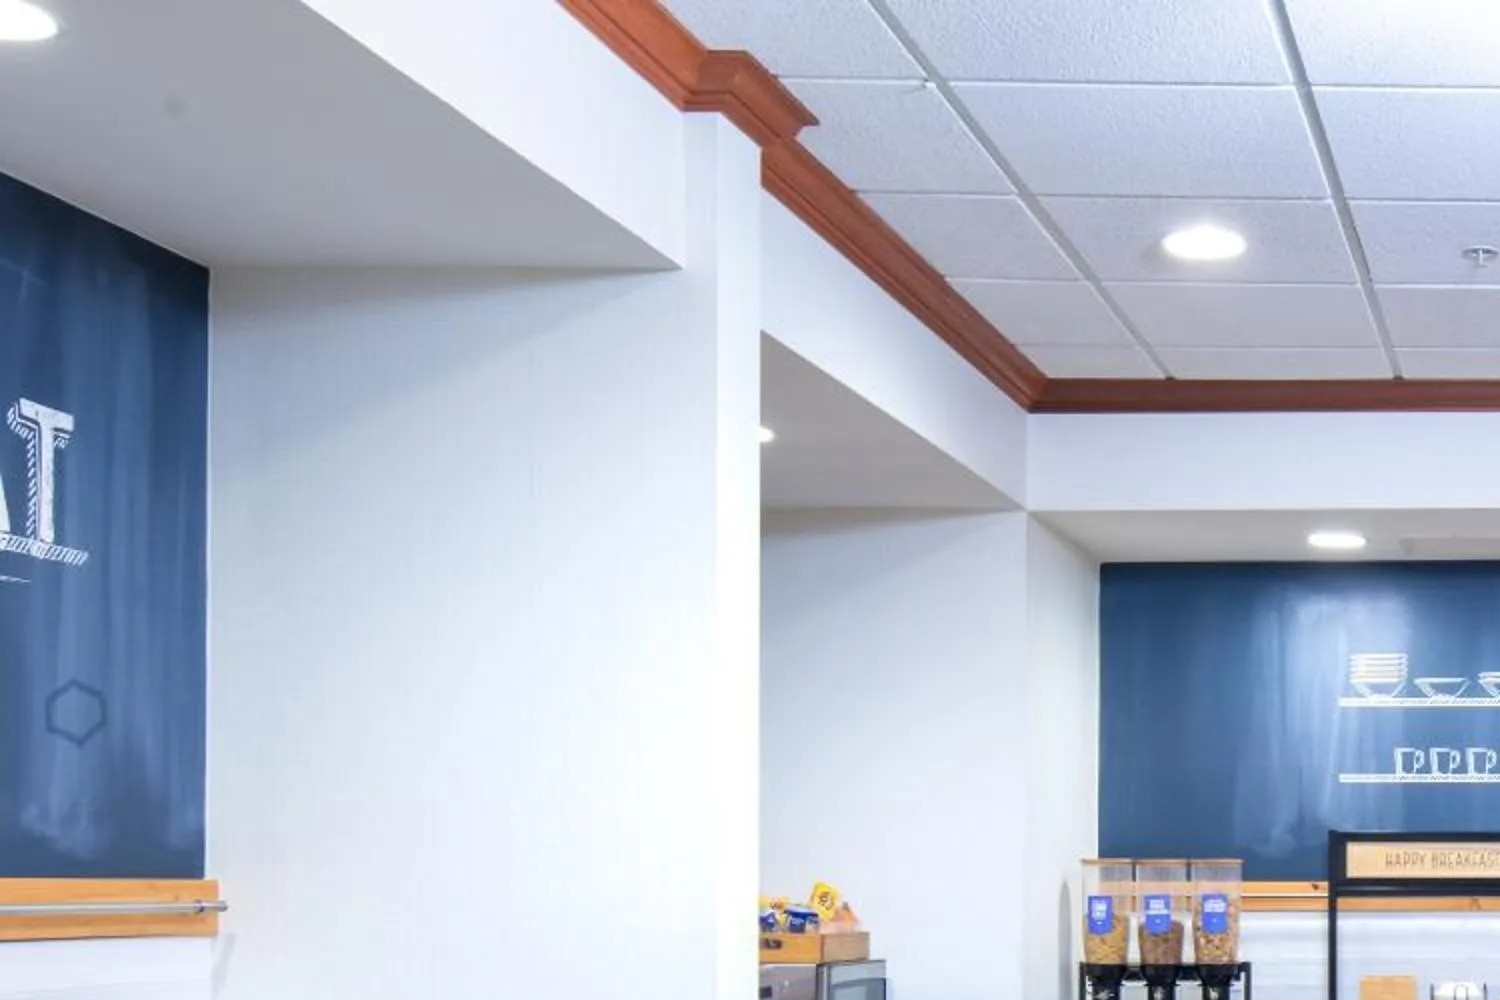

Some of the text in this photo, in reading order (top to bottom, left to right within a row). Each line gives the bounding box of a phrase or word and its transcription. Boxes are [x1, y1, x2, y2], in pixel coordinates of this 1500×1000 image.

[0, 396, 88, 562] T
[1385, 850, 1427, 869] HAPPY
[1431, 850, 1500, 869] BREAKFAST
